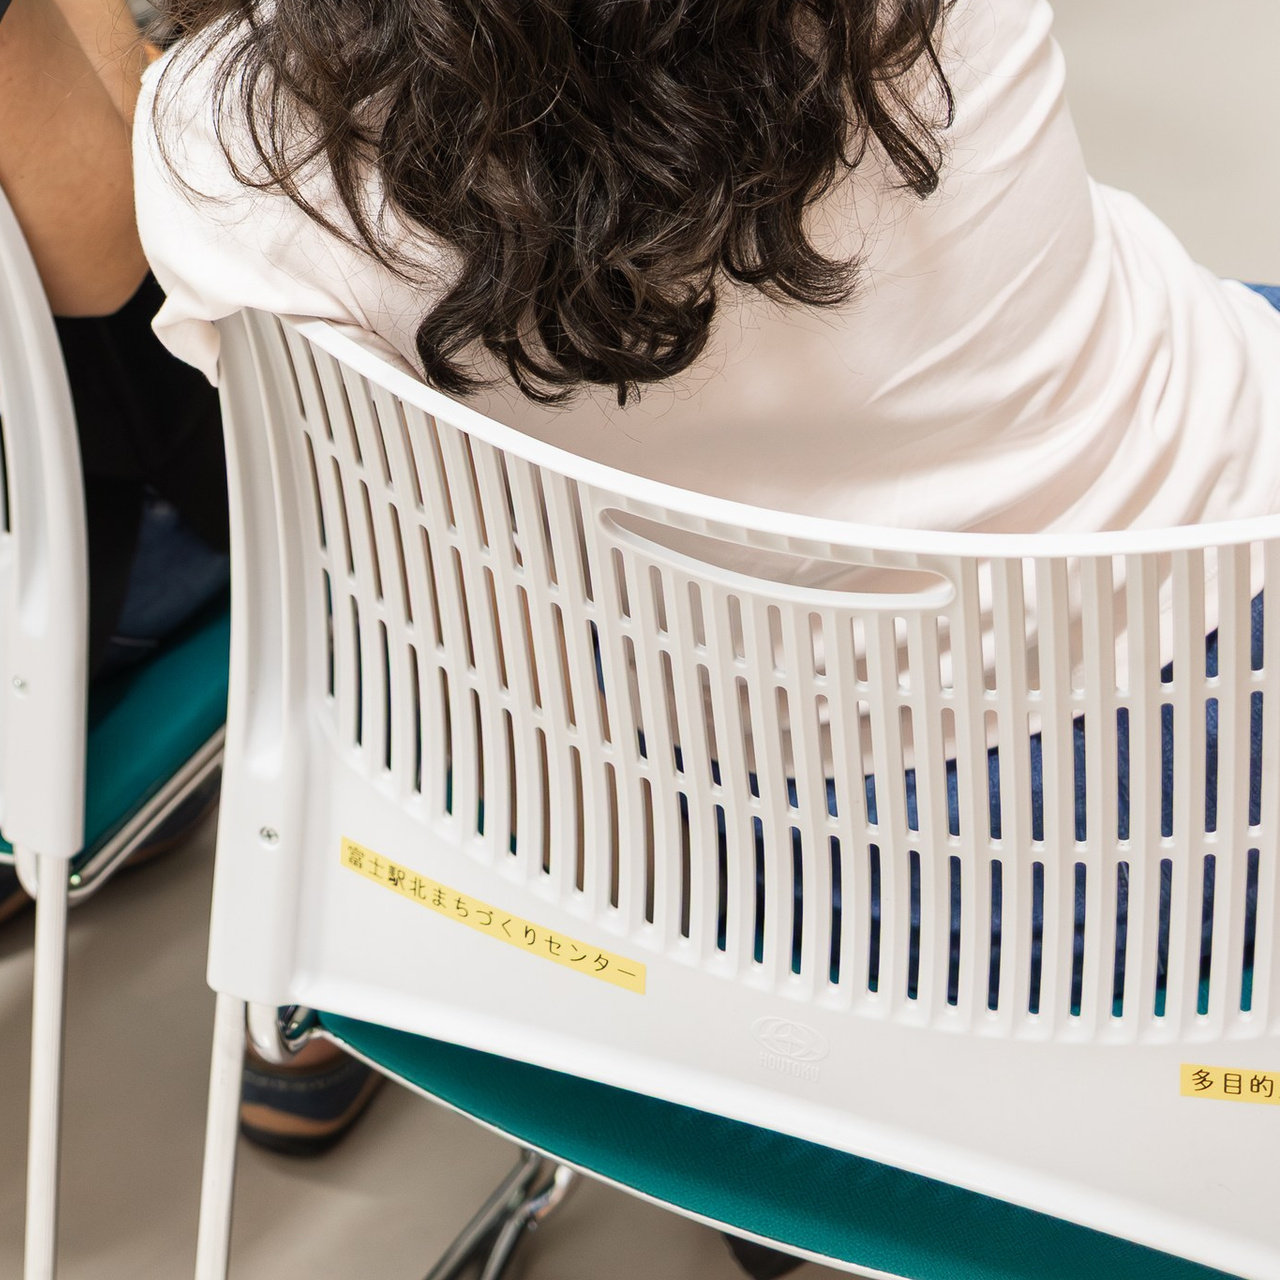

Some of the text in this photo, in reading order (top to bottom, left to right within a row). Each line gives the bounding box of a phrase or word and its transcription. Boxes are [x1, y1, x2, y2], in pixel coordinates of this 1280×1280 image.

[347, 845, 636, 978] 富士駅北まちづくりセンター
[758, 1050, 821, 1083] HOUTOKU
[1191, 1068, 1280, 1099] 多目的
